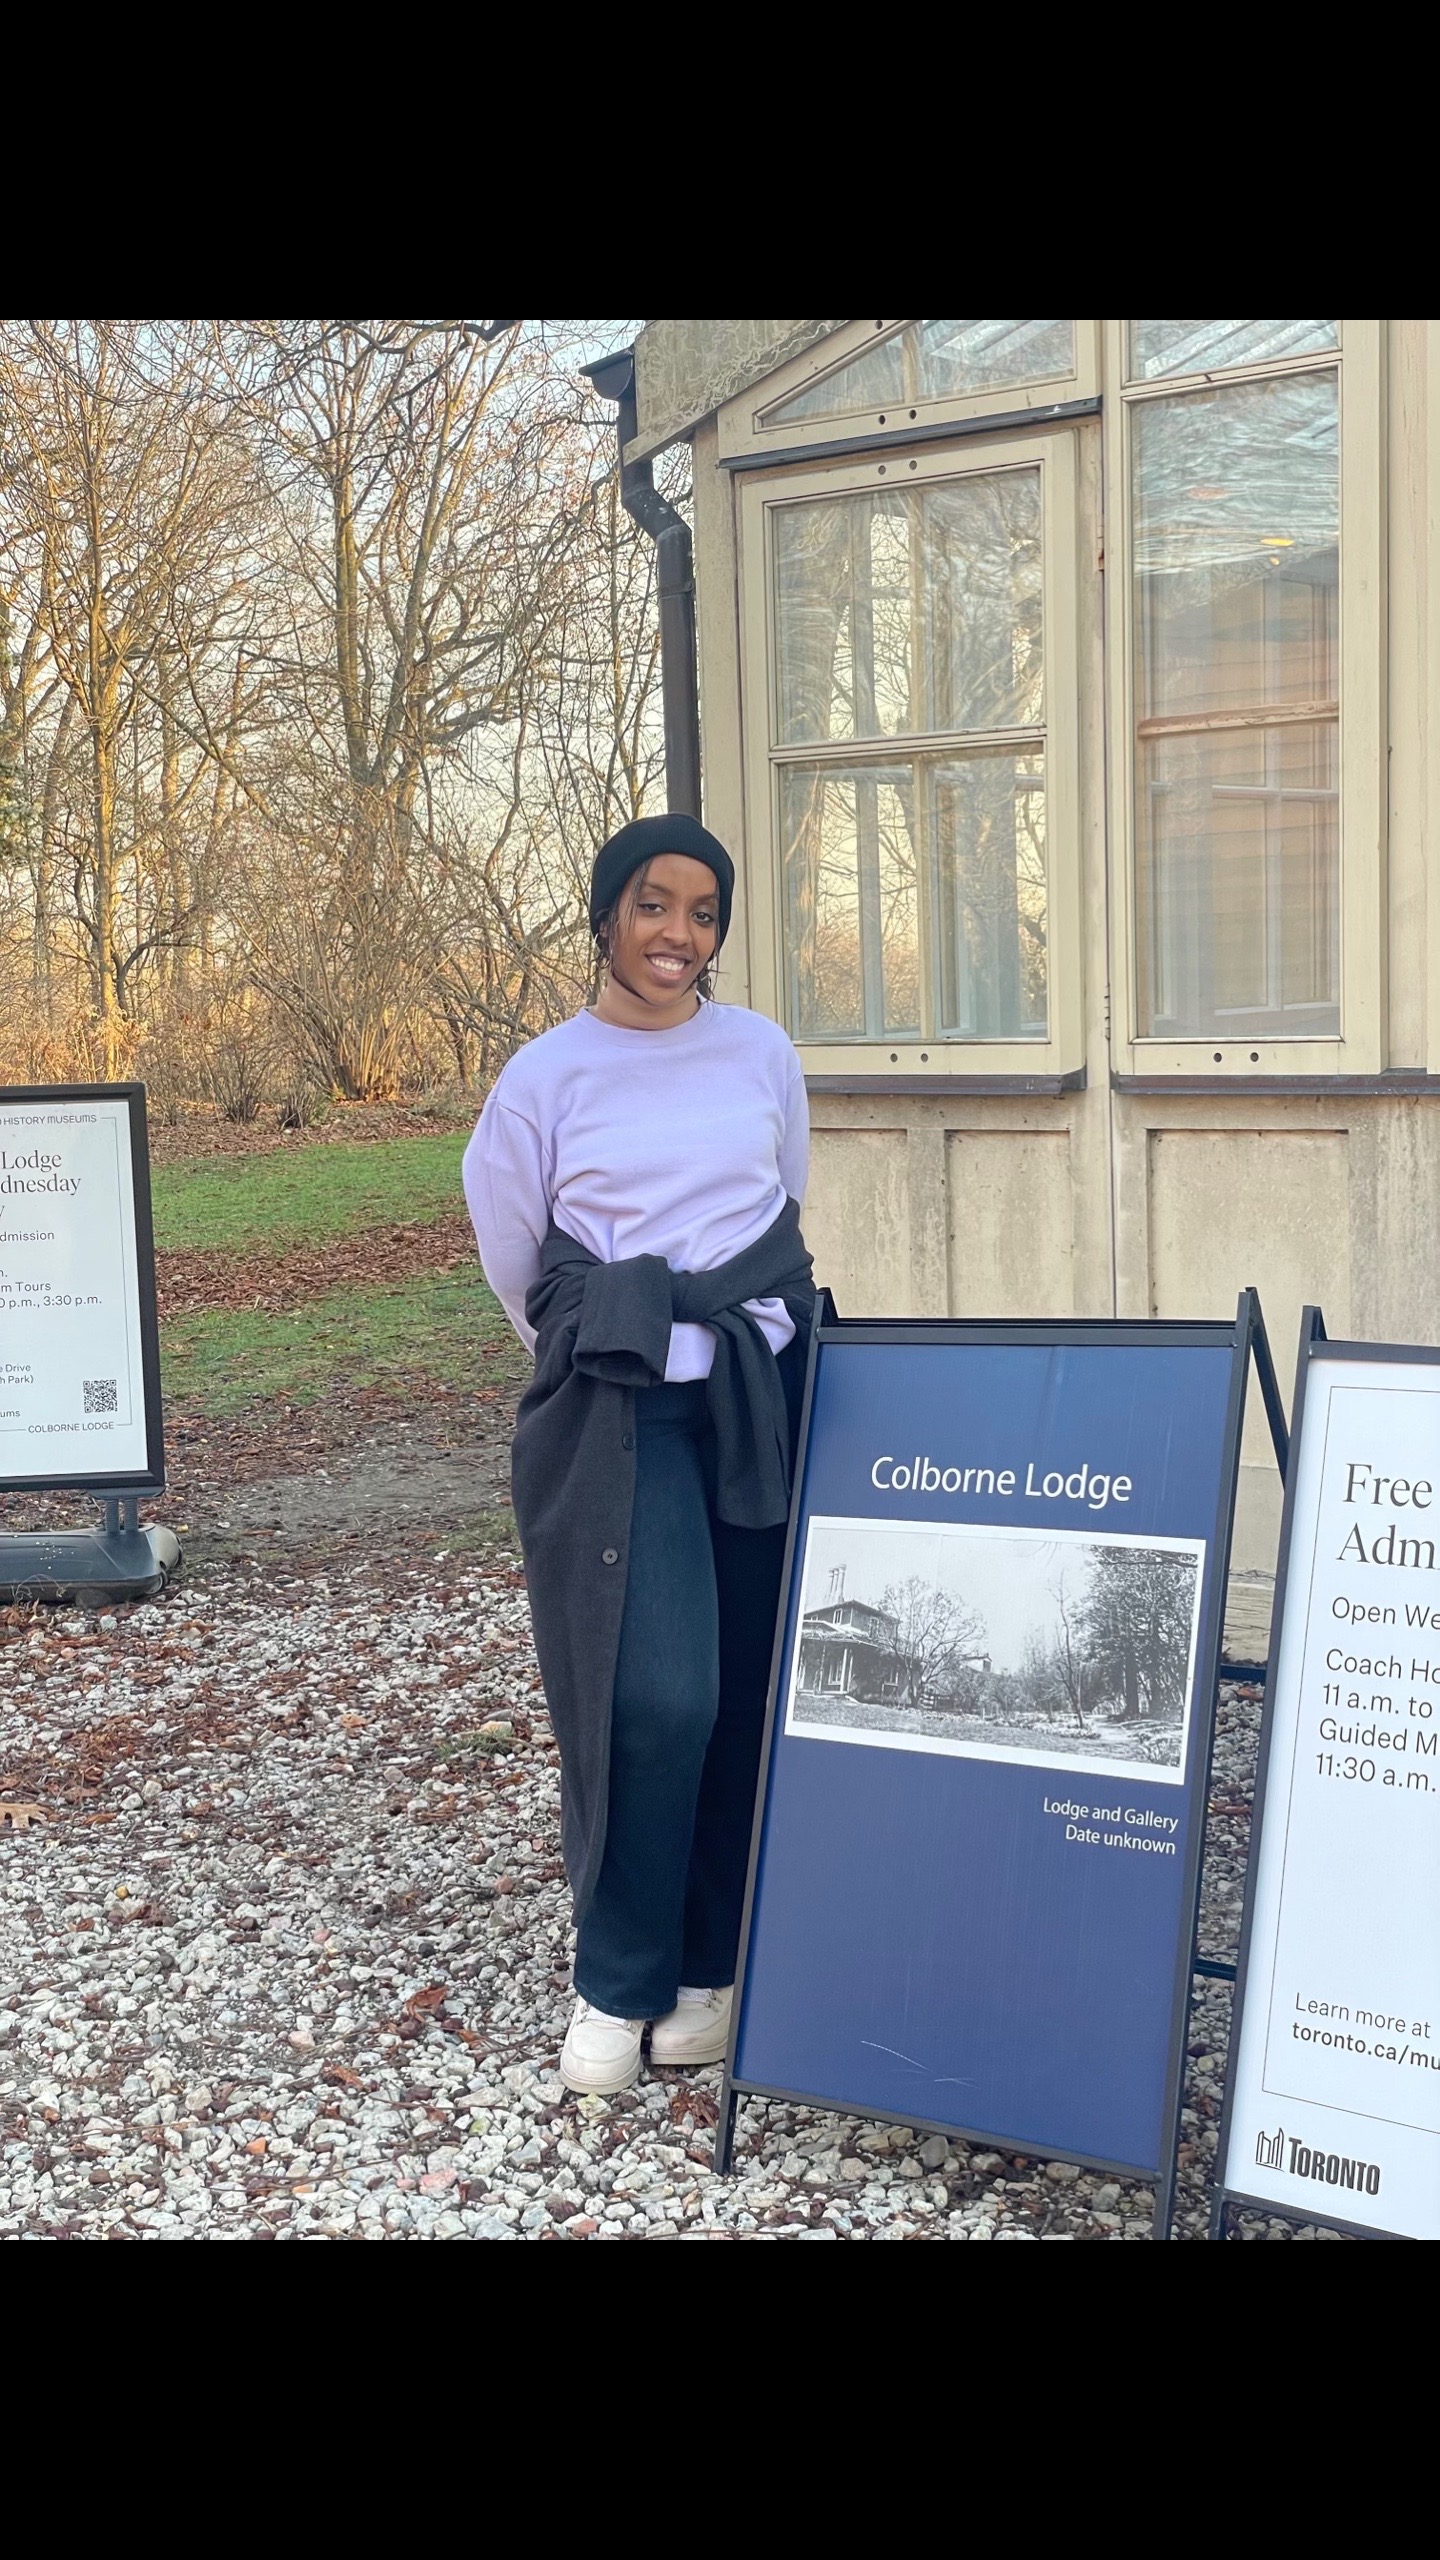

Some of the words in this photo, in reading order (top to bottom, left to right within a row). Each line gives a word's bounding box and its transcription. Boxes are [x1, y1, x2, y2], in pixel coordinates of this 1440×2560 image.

[3, 1116, 45, 1125] HISTORY
[47, 1114, 97, 1124] MUSEUMS
[2, 1149, 62, 1172] Lodge
[15, 1281, 52, 1292] Tours
[43, 1295, 72, 1306] 3:30
[75, 1295, 102, 1305] p.m.
[5, 1363, 31, 1372] Drive
[8, 1374, 34, 1384] Park)
[28, 1423, 80, 1433] COLBORNE
[82, 1421, 114, 1431] LODGE
[871, 1456, 1016, 1495] Colborne
[1025, 1463, 1132, 1510] Lodge
[1343, 1463, 1433, 1509] Free
[1335, 1522, 1440, 1570] Adm
[1332, 1596, 1396, 1625] Open
[1326, 1648, 1402, 1679] Coach
[1323, 1683, 1340, 1706] 11
[1347, 1692, 1399, 1715] a.m.
[1408, 1696, 1433, 1719] to
[1319, 1717, 1408, 1751] Guided
[1415, 1730, 1438, 1756] M
[1316, 1752, 1376, 1782] 11:30
[1382, 1768, 1436, 1793] a.m.
[1043, 1797, 1089, 1820] Lodge
[1092, 1806, 1121, 1821] and
[1124, 1808, 1179, 1833] Gallery
[1065, 1824, 1100, 1843] Date
[1103, 1832, 1176, 1855] unknown
[1295, 1992, 1349, 2021] Learn
[1355, 2010, 1406, 2033] more
[1411, 2021, 1431, 2039] at
[1293, 2022, 1440, 2070] toronto.ca/mu
[1288, 2136, 1381, 2196] TORONTO
